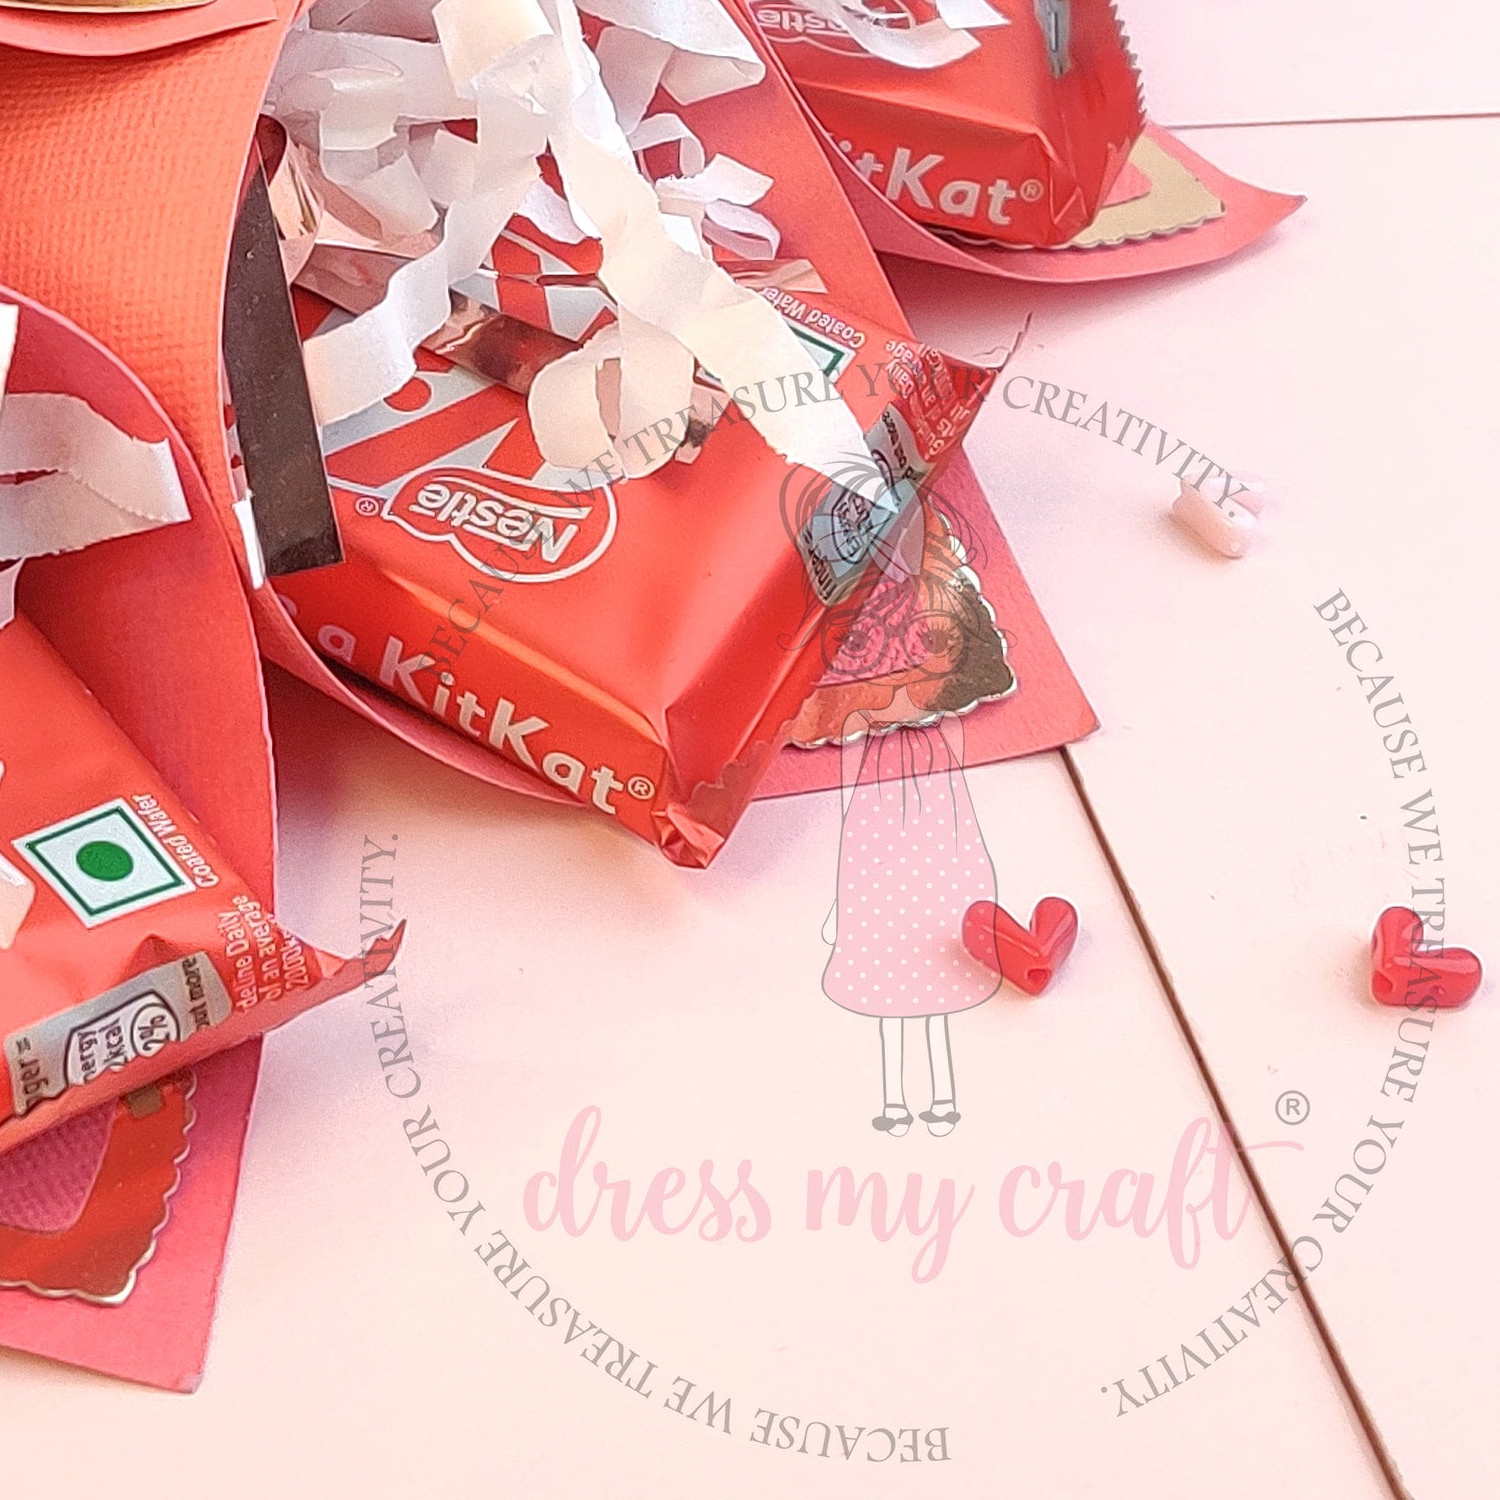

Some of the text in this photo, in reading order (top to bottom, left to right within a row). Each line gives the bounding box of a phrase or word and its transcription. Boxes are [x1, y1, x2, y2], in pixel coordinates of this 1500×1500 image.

[806, 308, 866, 350] Coated
[132, 793, 177, 837] Wafer
[218, 909, 249, 957] Daily
[76, 1029, 98, 1081] nergy
